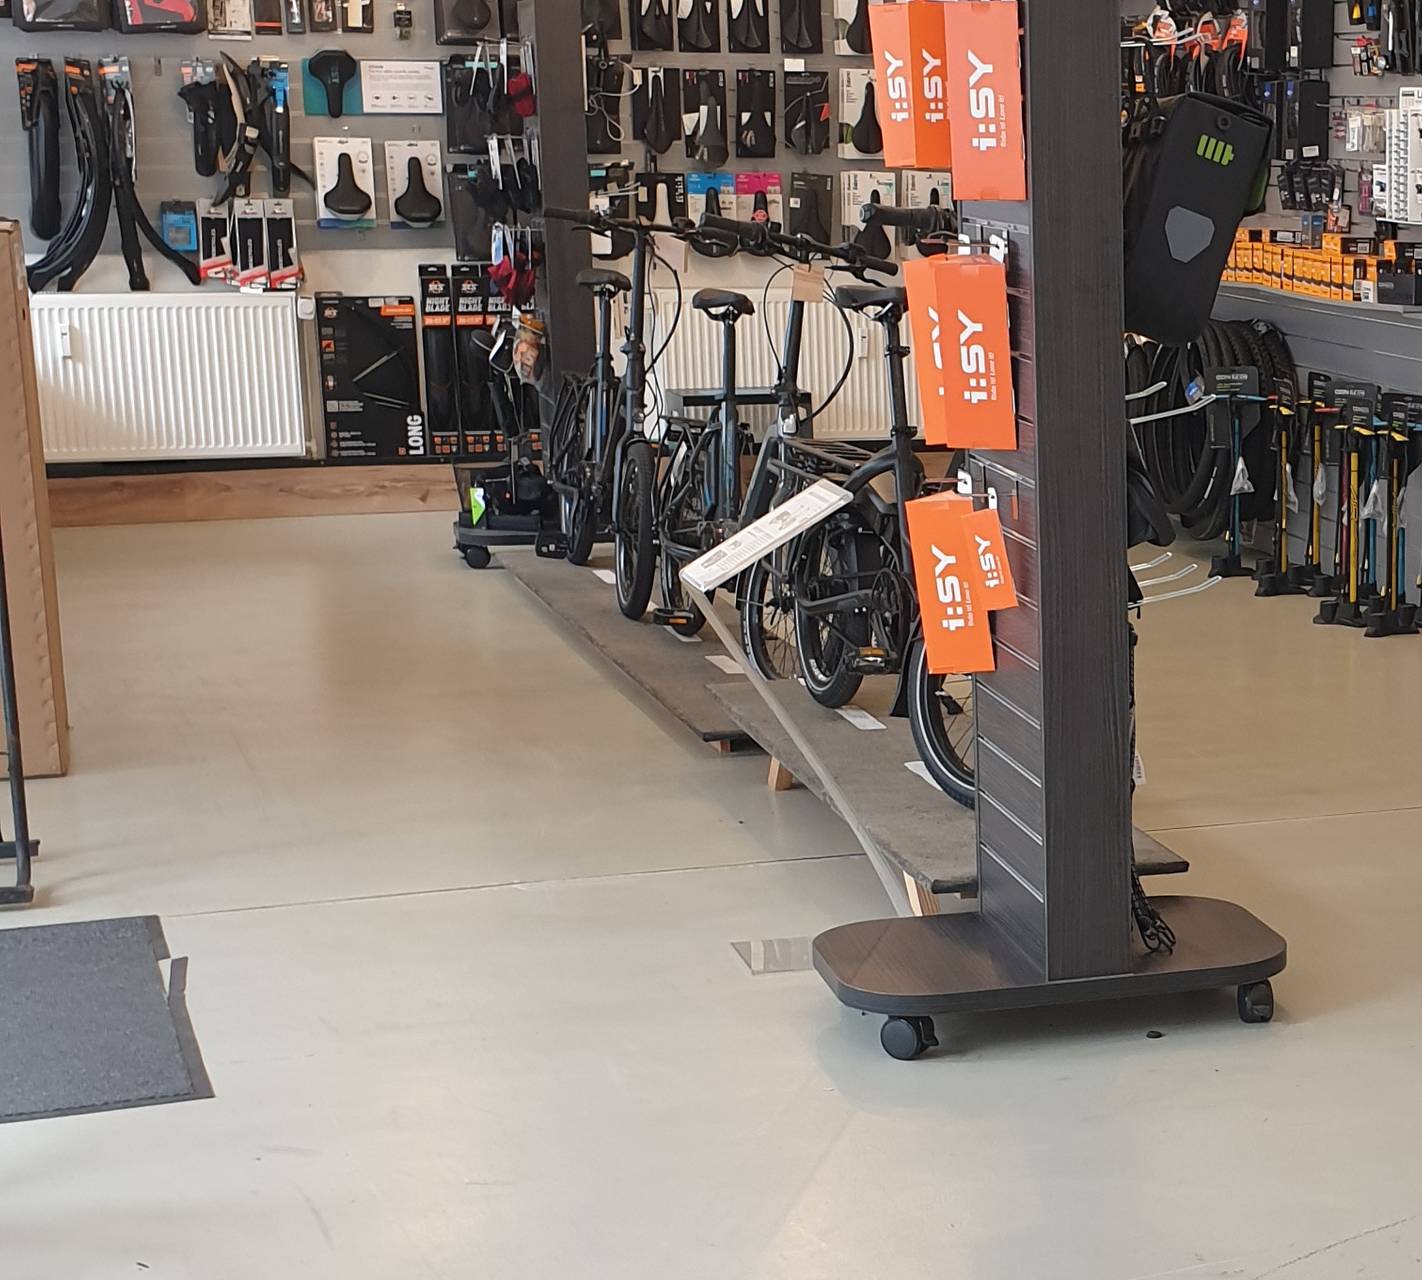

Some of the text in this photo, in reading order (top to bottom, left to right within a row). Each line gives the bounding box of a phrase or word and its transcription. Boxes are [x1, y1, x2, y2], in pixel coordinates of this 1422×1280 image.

[967, 49, 997, 151] i:SY
[957, 308, 988, 404] i:SY
[406, 414, 425, 456] LONG
[931, 543, 966, 632] i:SY
